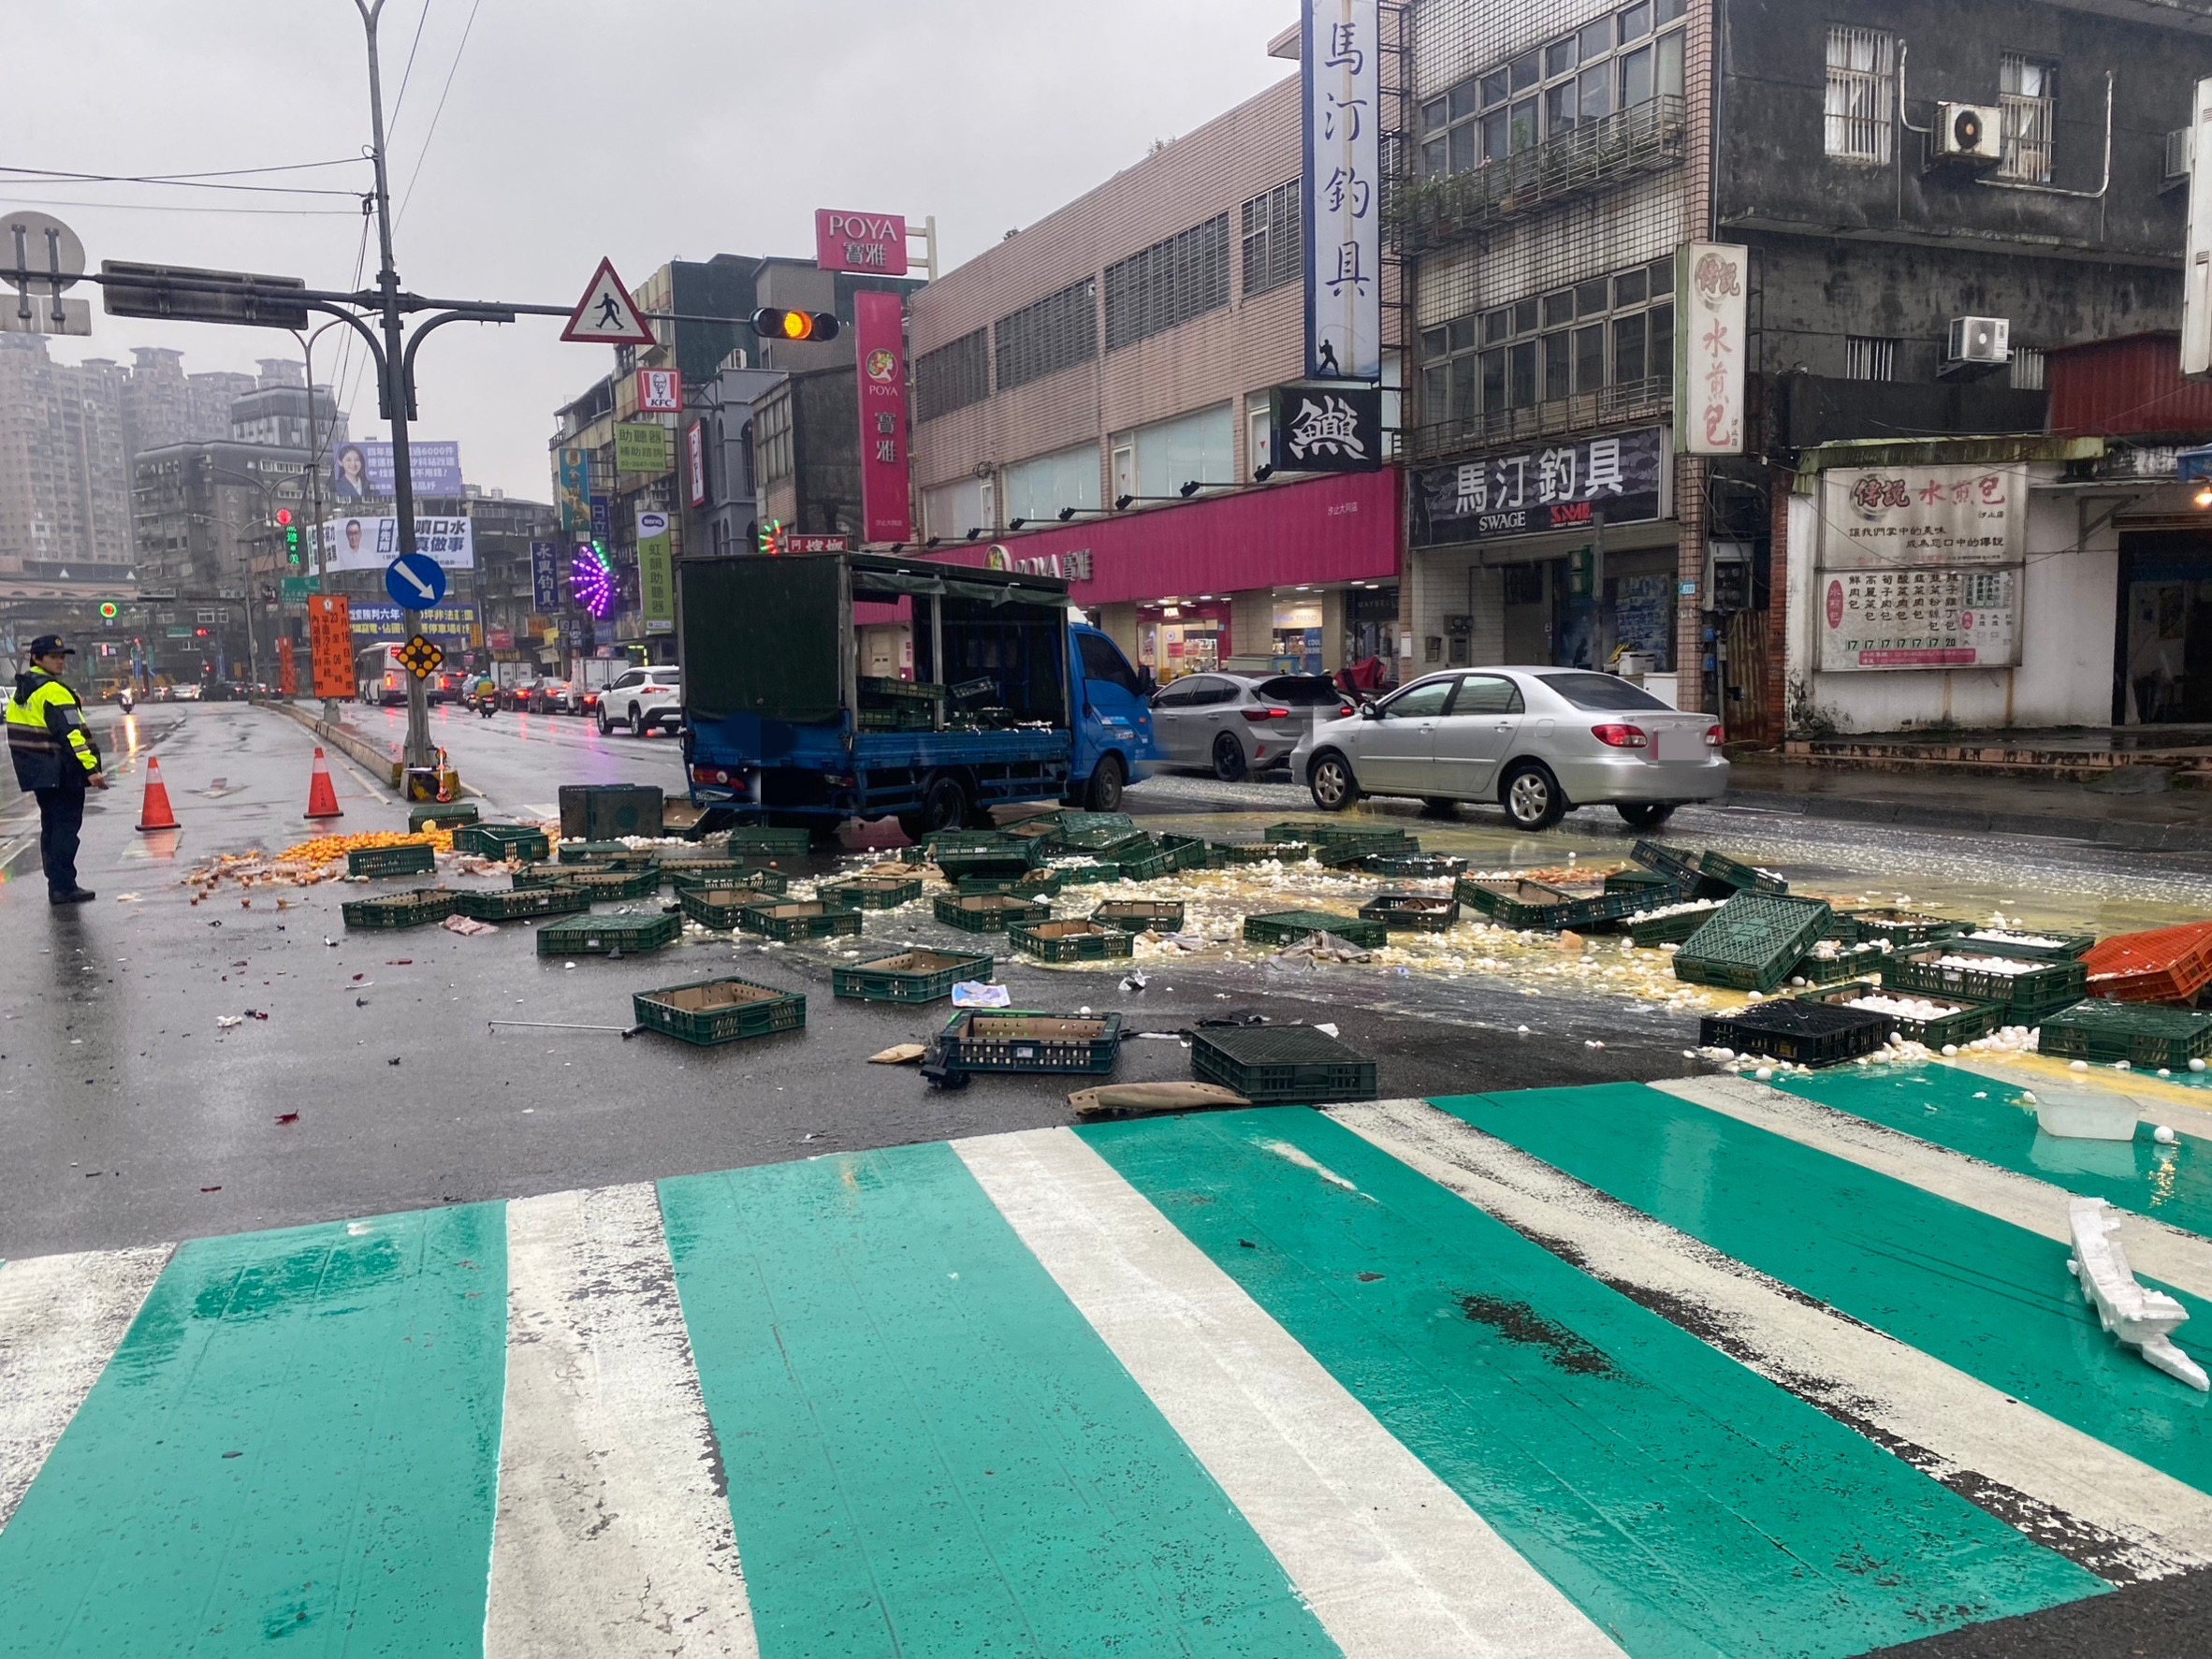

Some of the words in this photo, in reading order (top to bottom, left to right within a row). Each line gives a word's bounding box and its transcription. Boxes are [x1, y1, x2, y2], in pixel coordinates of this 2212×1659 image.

[1325, 22, 1370, 297] 馬汀釣具
[829, 215, 897, 241] POYA
[843, 241, 887, 266] 寶雅
[868, 385, 898, 397] POYA
[1702, 318, 1733, 446] 水煎包
[650, 399, 672, 407] KFC
[619, 429, 661, 444] 助聽器
[875, 412, 897, 463] 寶雅
[1455, 438, 1623, 515] 馬汀釣具
[1919, 476, 2005, 506] 水煎包
[1854, 478, 1911, 507] 傳說
[592, 505, 607, 535] 日立
[1478, 511, 1526, 531] SWAGE
[1849, 526, 1946, 538] 讓我們掌中的美味
[535, 544, 554, 607] 永興釣具
[648, 544, 663, 614] 虹韻助聽器
[1847, 640, 1857, 649] 17
[1864, 640, 1874, 649] 17
[1881, 639, 1890, 648] 17
[1897, 639, 1906, 648] 17
[1912, 638, 1921, 648] 17
[1928, 638, 1939, 648] 17
[1945, 637, 1956, 647] 20
